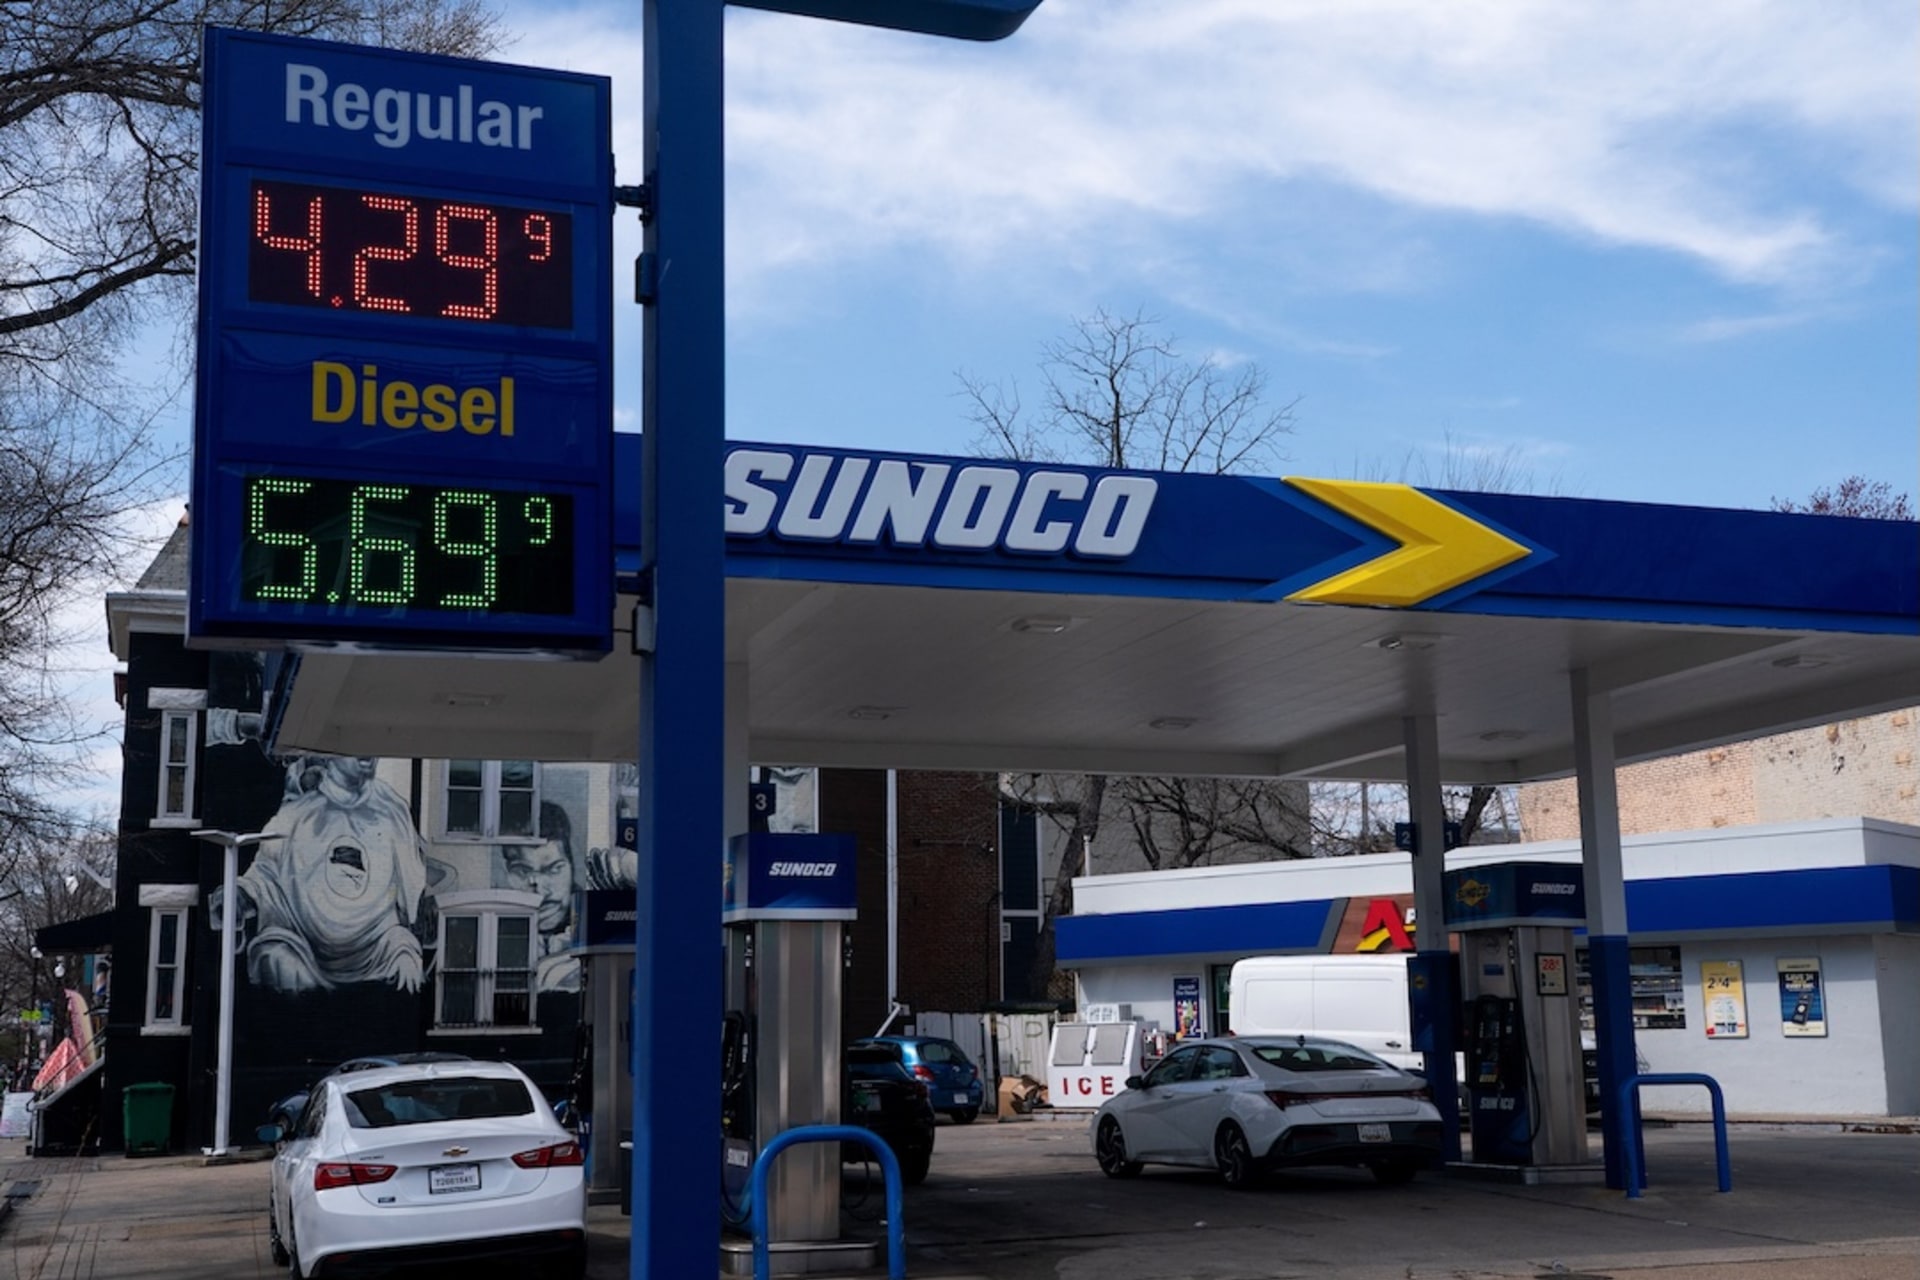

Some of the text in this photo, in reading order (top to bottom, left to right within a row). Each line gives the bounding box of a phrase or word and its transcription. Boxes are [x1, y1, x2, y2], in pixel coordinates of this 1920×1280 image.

[285, 63, 544, 150] Regular
[256, 188, 498, 320] 4.29
[311, 361, 515, 436] Diesel
[723, 448, 1159, 558] SUNOCO
[250, 477, 497, 609] 5.69
[754, 792, 768, 811] 3
[623, 826, 635, 843] 6
[1401, 830, 1411, 845] 2
[1445, 829, 1454, 845] 1
[768, 861, 838, 877] SUNOCO
[1530, 882, 1577, 895] SUNOCO
[1063, 1075, 1115, 1096] ICE
